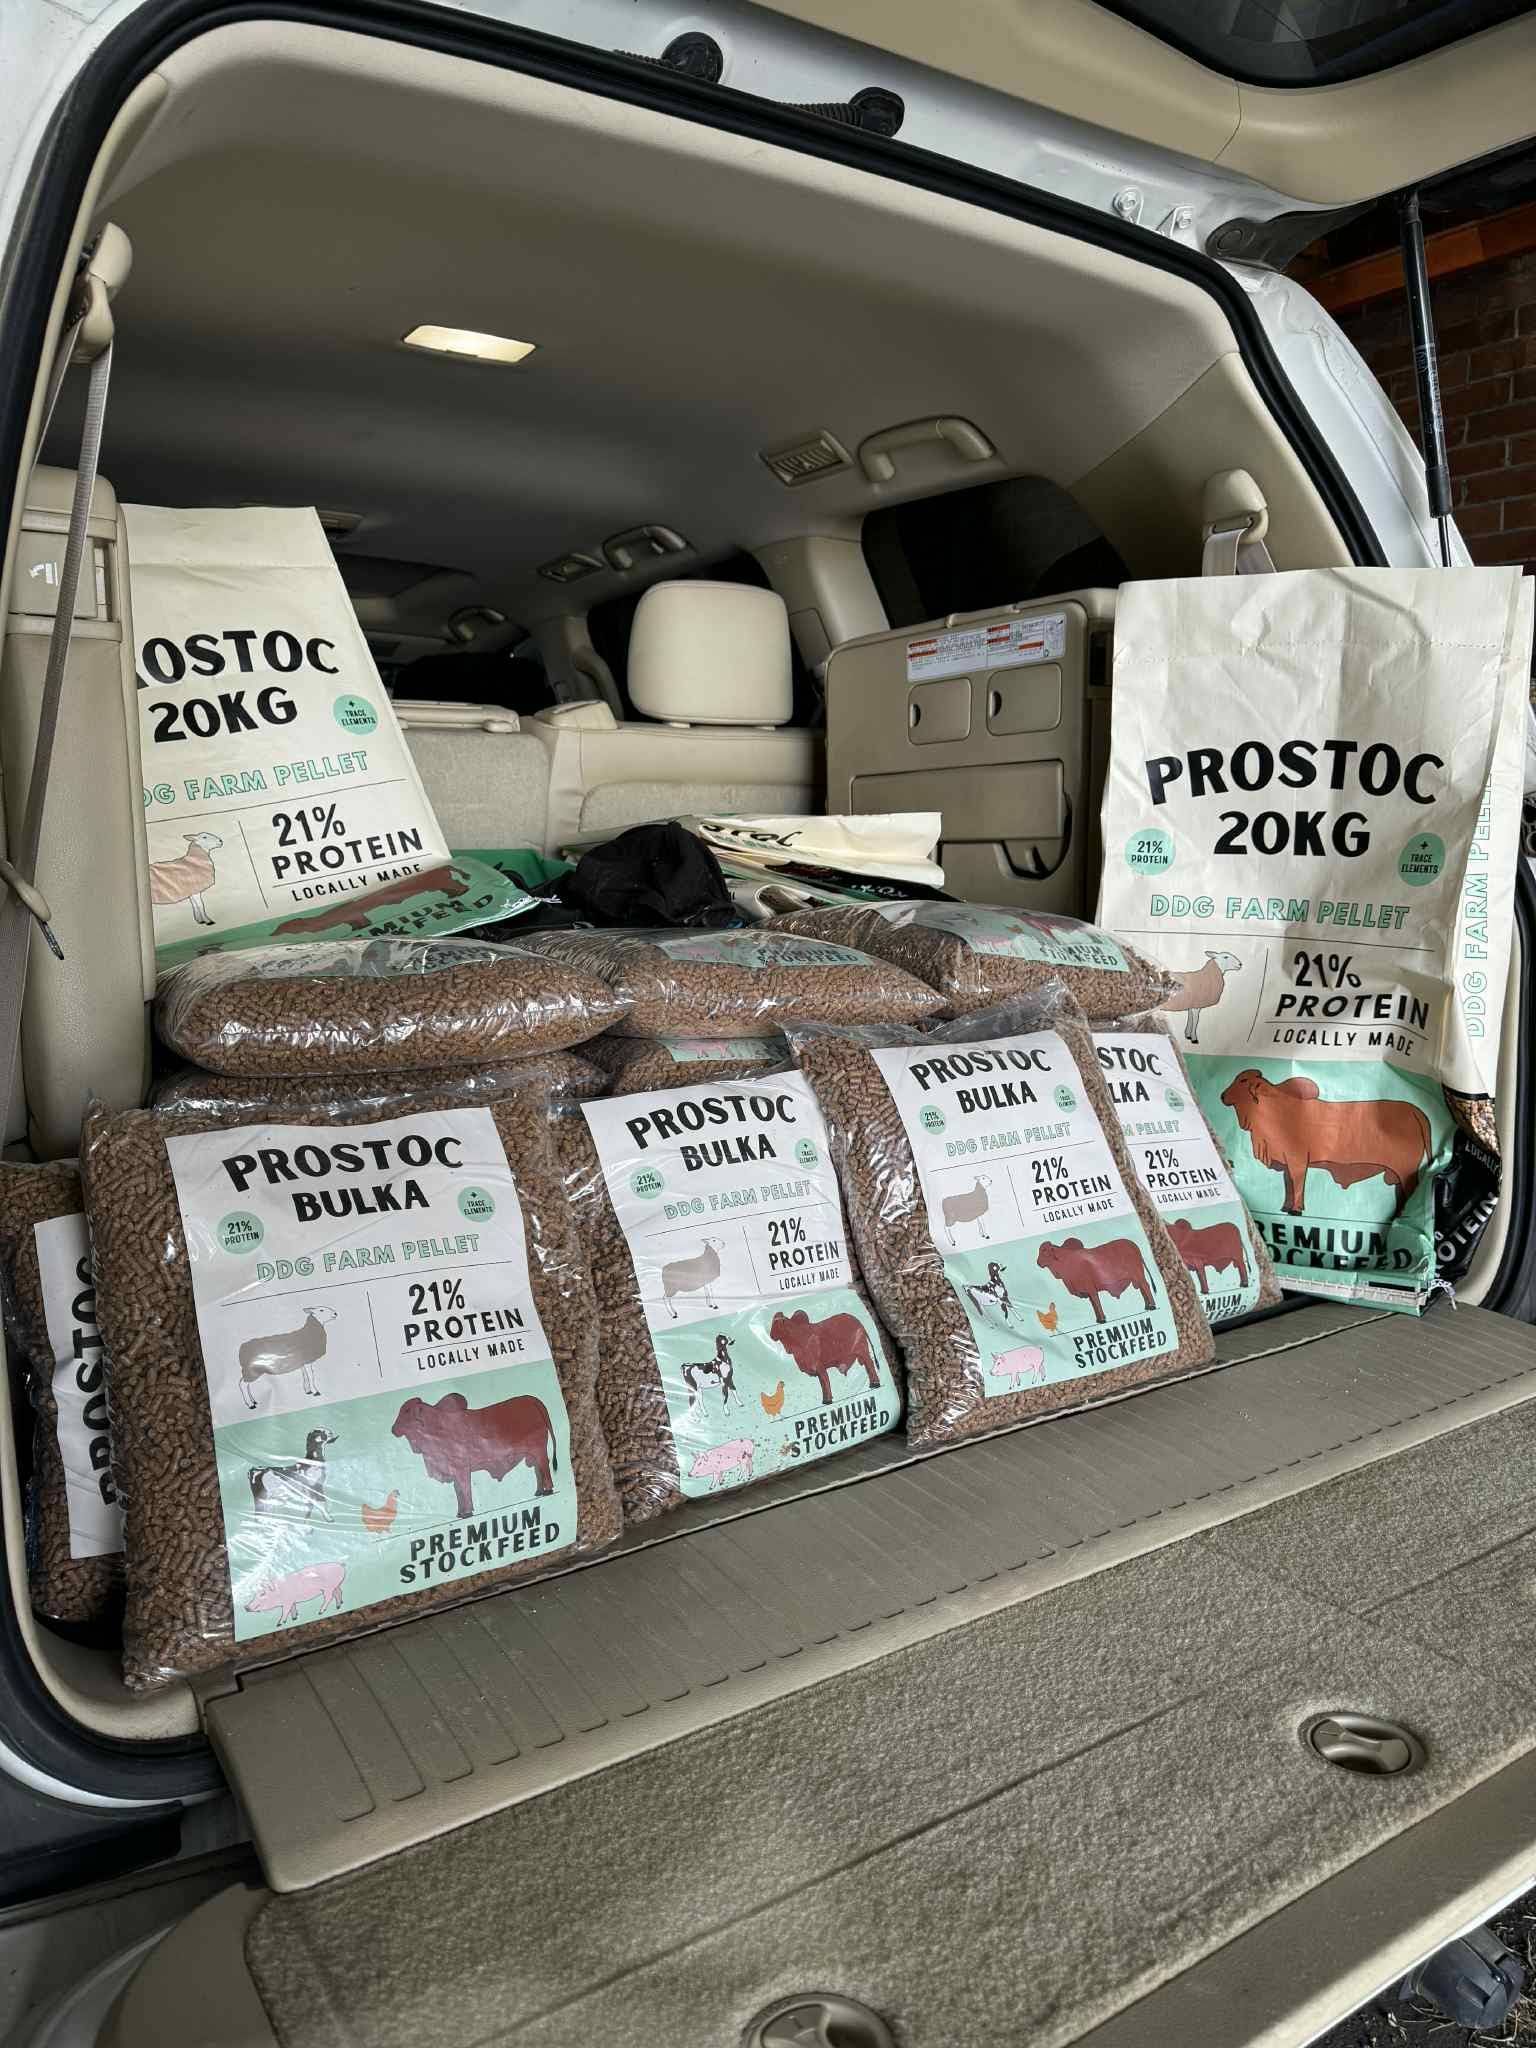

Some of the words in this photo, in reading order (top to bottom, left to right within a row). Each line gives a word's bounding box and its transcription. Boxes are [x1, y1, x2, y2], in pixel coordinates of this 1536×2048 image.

[137, 630, 339, 689] OSTOC
[149, 687, 297, 743] 20KG
[184, 769, 267, 800] FARM
[273, 751, 368, 787] PELLET
[1145, 739, 1444, 805] PROSTOC
[272, 803, 345, 847] 21%
[1214, 811, 1370, 857] 20KG
[272, 827, 423, 879] PROTEIN
[1131, 855, 1168, 864] PROTEIN
[1137, 840, 1163, 853] 21%
[1411, 854, 1432, 863] TRACE
[291, 874, 368, 902] LOCALLY
[378, 863, 424, 883] MADE
[1401, 863, 1439, 873] ELEMENTS
[1150, 895, 1215, 919] DDG
[1226, 897, 1309, 923] FARM
[1316, 901, 1410, 929] PELLET
[1465, 873, 1488, 960] FARM
[1294, 951, 1362, 989] 21%
[1275, 993, 1430, 1030] PROTEIN
[1273, 1029, 1356, 1047] LOCALLY
[1369, 1032, 1414, 1056] MADE
[909, 1049, 1052, 1091] PROSTOC
[1097, 1046, 1162, 1076] STOC
[956, 1080, 1038, 1113] BULKA
[1108, 1081, 1150, 1103] LKA
[625, 1094, 797, 1150] PROSTOC
[945, 1137, 978, 1157] DDG
[982, 1131, 1022, 1152] FARM
[1024, 1122, 1072, 1143] PELLET
[1136, 1120, 1180, 1135] PELLET
[222, 1134, 463, 1192] PROSTOC
[680, 1133, 777, 1172] BULKA
[1031, 1156, 1069, 1184] 21%
[1145, 1149, 1179, 1170] 21%
[636, 1172, 655, 1185] 21%
[1032, 1174, 1112, 1206] PROTEIN
[1147, 1167, 1218, 1188] PROTEIN
[292, 1180, 430, 1223] BULKA
[664, 1198, 705, 1220] DDG
[708, 1188, 758, 1211] FARM
[760, 1180, 812, 1201] PELLET
[1043, 1207, 1085, 1223] LOCALLY
[1088, 1198, 1115, 1214] MADE
[1157, 1191, 1194, 1204] LOCALLY
[1196, 1187, 1221, 1199] MADE
[225, 1232, 260, 1246] PROTEIN
[228, 1220, 253, 1235] 21%
[768, 1217, 806, 1247] 21%
[256, 1256, 314, 1282] DDG
[323, 1244, 396, 1272] FARM
[402, 1234, 480, 1260] PELLET
[768, 1240, 840, 1271] PROTEIN
[779, 1274, 816, 1290] LOCALLY
[819, 1268, 840, 1282] MADE
[408, 1278, 466, 1316] 21%
[1201, 1294, 1241, 1313] MIUM
[403, 1308, 525, 1347] PROTEIN
[1073, 1318, 1153, 1350] PREMIUM
[417, 1349, 479, 1371] LOCALLY
[487, 1338, 525, 1358] MADE
[1074, 1331, 1167, 1368] STOCKFEED
[789, 1410, 890, 1458] STOCKFEED
[795, 1396, 877, 1438] PREMIUM
[410, 1506, 541, 1561] PREMIUM
[400, 1523, 560, 1584] STOCKFEED
